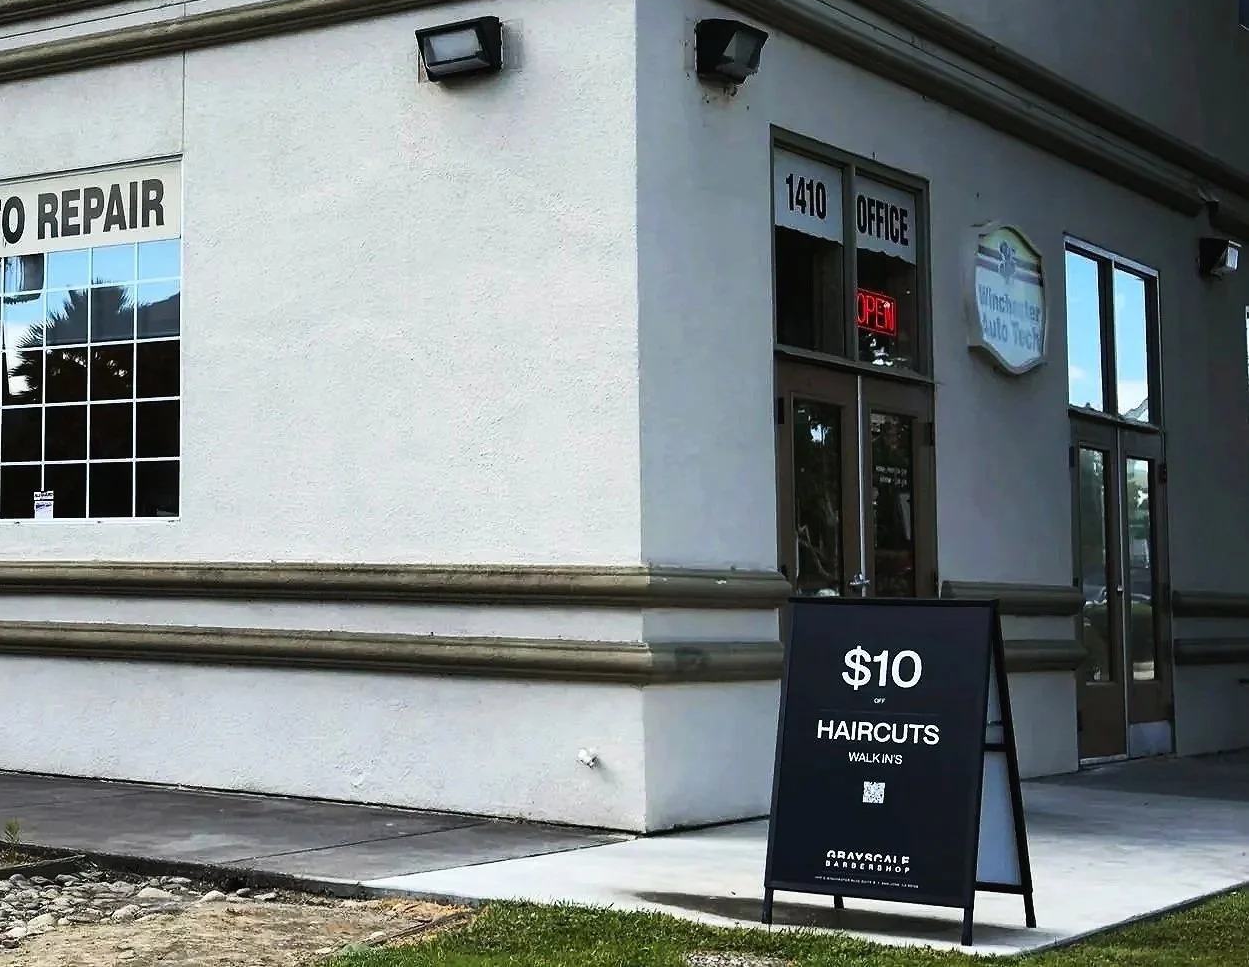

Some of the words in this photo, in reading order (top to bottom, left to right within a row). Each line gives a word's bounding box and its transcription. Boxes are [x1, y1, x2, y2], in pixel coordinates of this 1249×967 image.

[37, 178, 165, 240] REPAIR
[786, 173, 826, 219] 1410
[856, 194, 909, 246] OFFICE
[857, 292, 894, 331] OPEN
[978, 283, 1041, 323] Winchter
[841, 645, 923, 691] $10
[873, 696, 886, 704] OFF
[816, 719, 940, 746] HAIRCUTS
